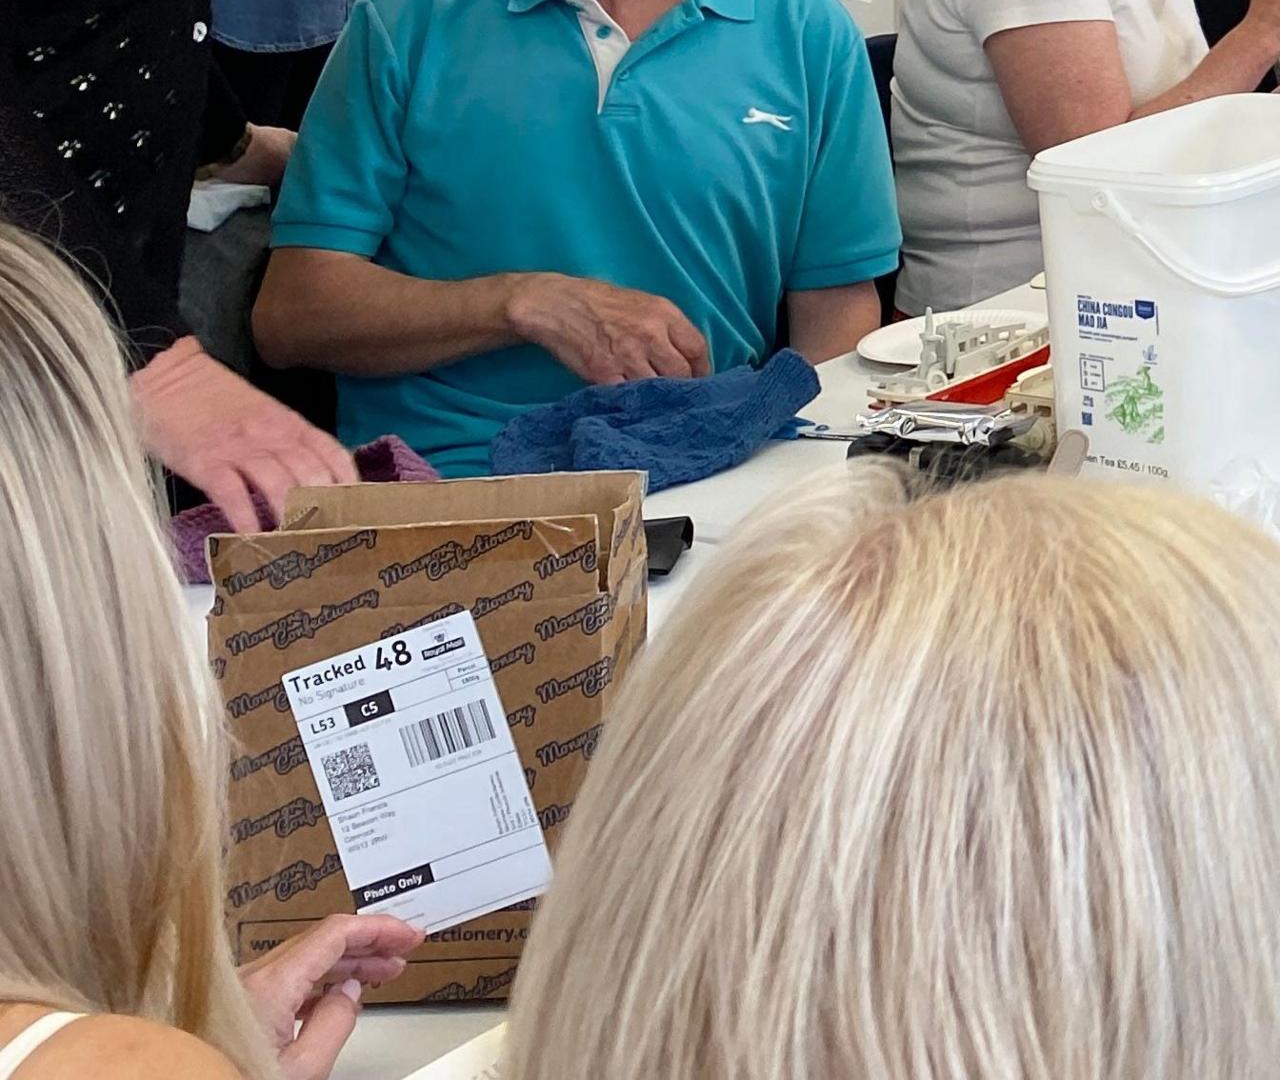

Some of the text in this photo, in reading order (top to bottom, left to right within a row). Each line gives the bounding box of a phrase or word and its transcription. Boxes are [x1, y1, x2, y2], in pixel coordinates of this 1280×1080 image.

[1077, 299, 1101, 315] CHINA
[1102, 302, 1134, 319] CONGOU
[1078, 313, 1095, 327] MAO
[1099, 456, 1115, 468] Tea
[1147, 465, 1168, 478] 100g
[269, 529, 378, 590] Confectionery
[379, 541, 462, 588] Monmore
[426, 520, 534, 581] Confectionery
[534, 538, 597, 580] Monmo
[273, 588, 380, 650] Confectionery
[471, 580, 534, 621] ctionery
[226, 609, 305, 655] Monmore
[288, 639, 413, 694] Tracked 48
[226, 680, 288, 719] Monm
[298, 692, 316, 706] No
[316, 676, 366, 701] Signature
[309, 716, 336, 735] L53
[360, 701, 379, 717] C5
[535, 722, 604, 767] Monmor
[363, 873, 424, 902] Photo Only
